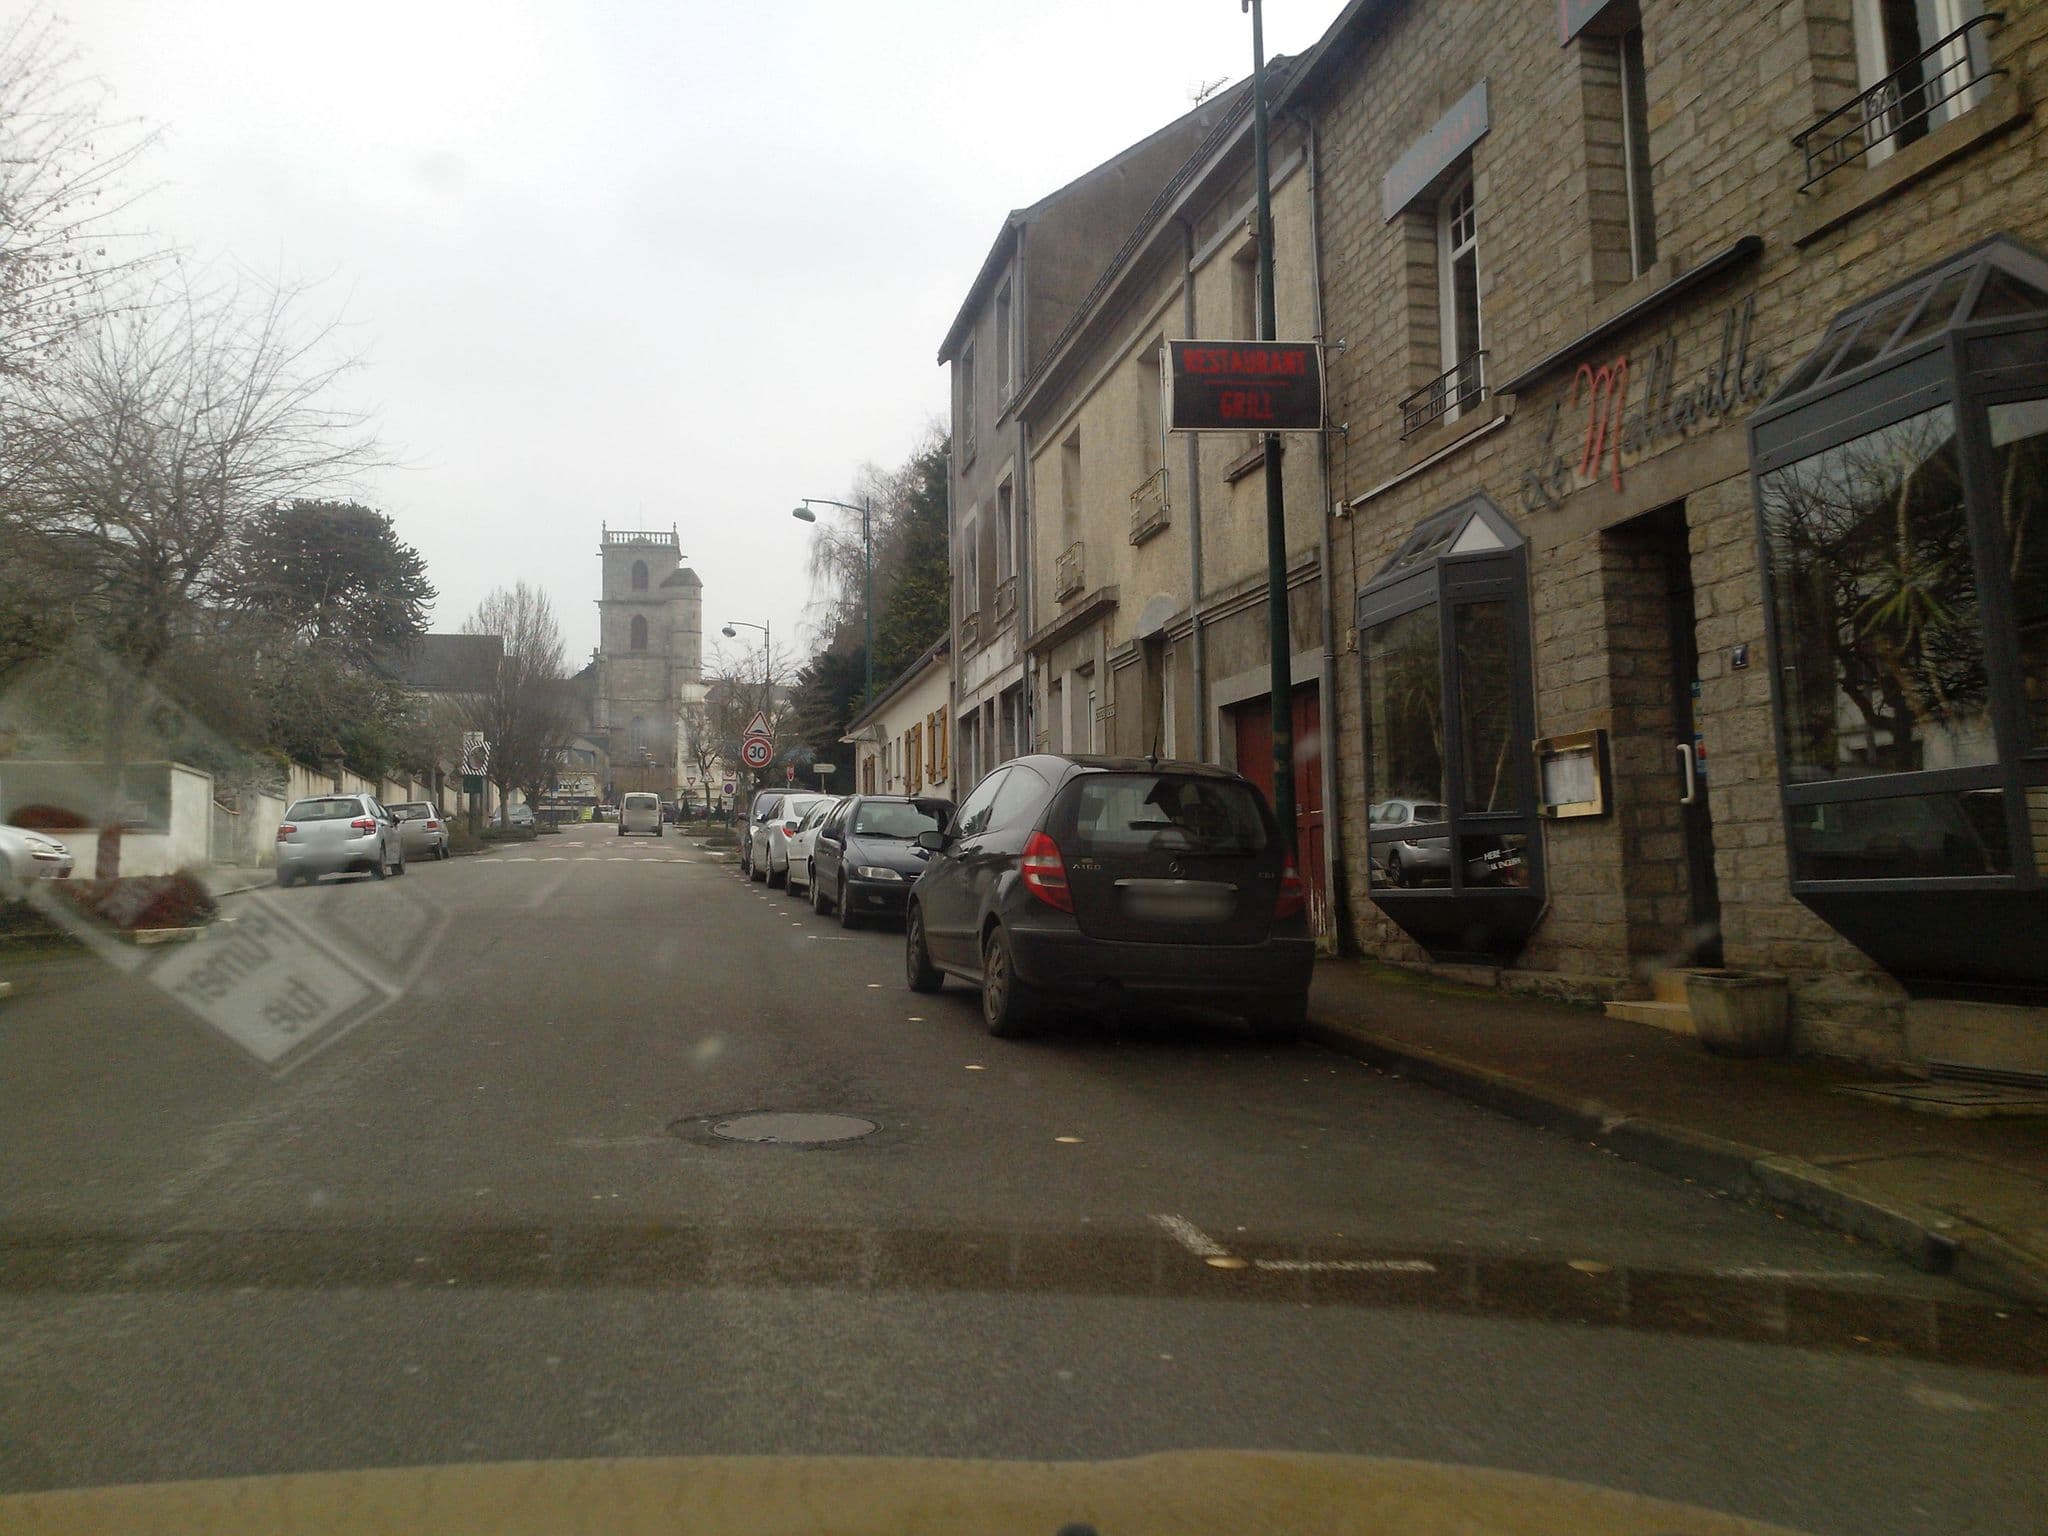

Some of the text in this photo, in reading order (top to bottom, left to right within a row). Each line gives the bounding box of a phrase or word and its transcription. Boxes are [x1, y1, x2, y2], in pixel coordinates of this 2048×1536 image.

[1182, 350, 1306, 376] RESTAURANT
[1220, 391, 1275, 420] GRILL
[749, 746, 766, 759] 30
